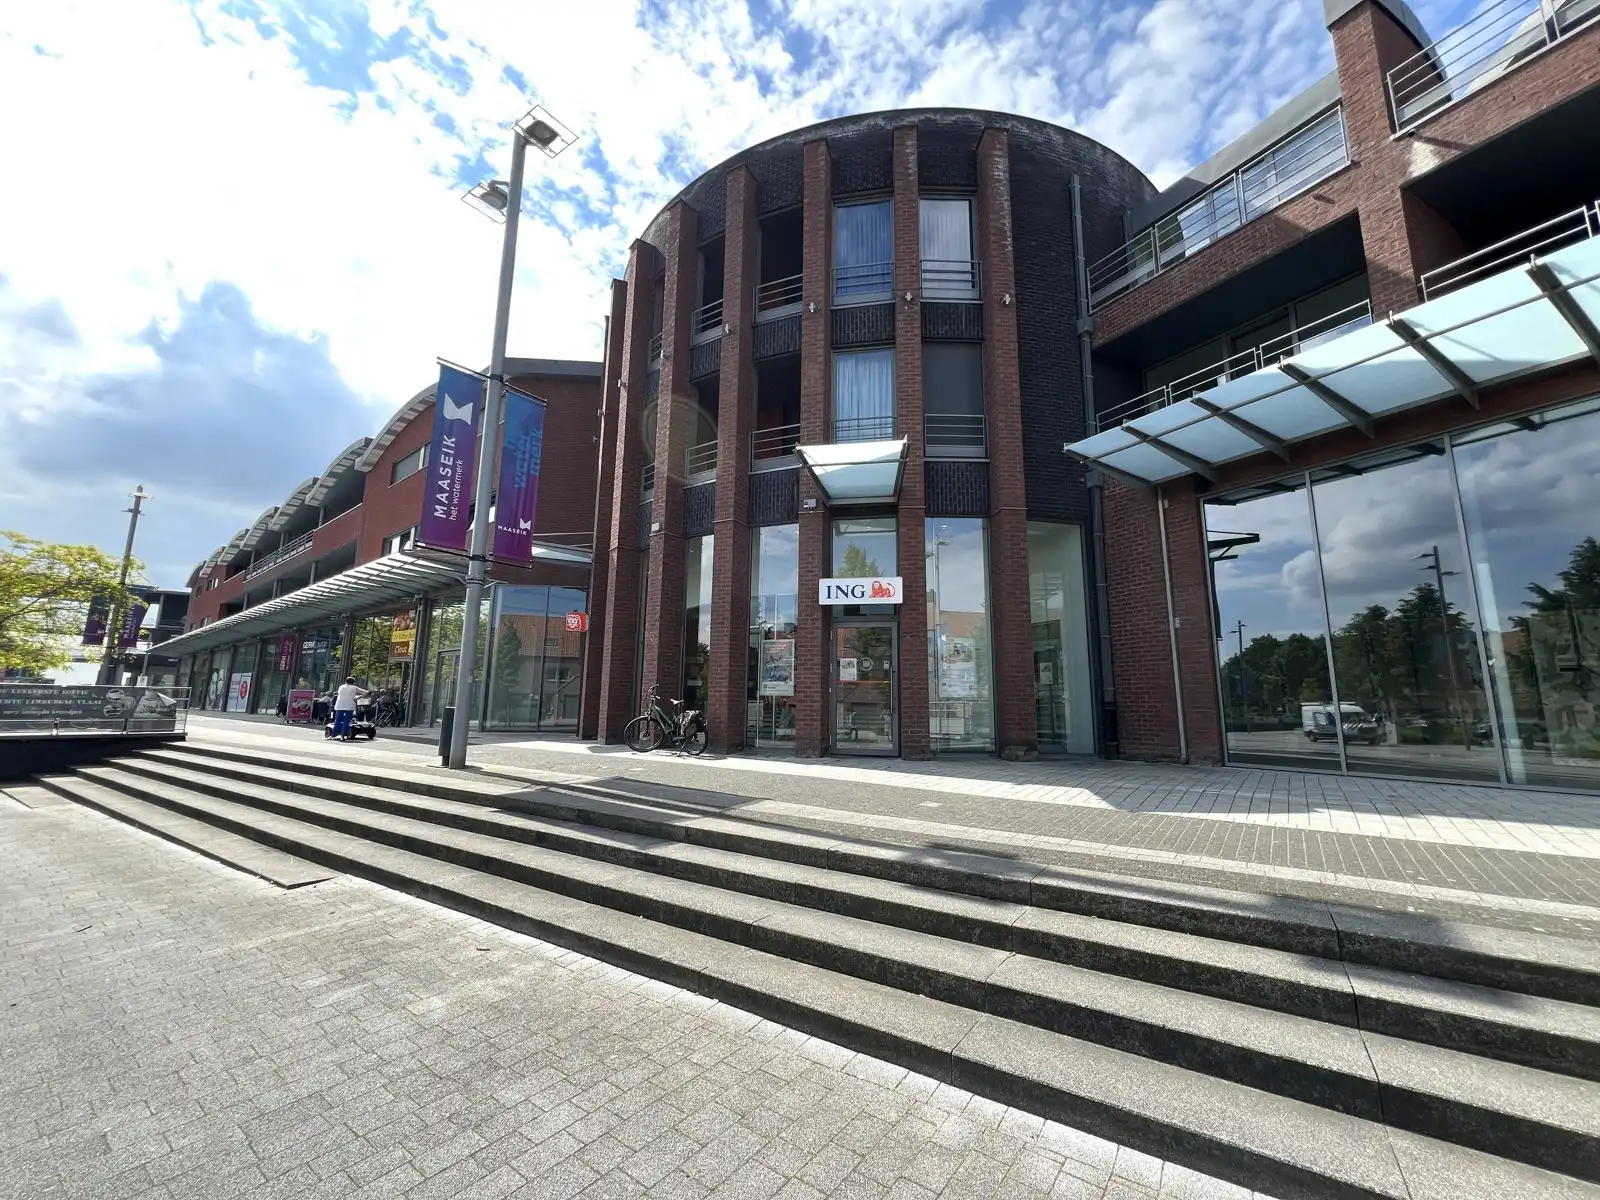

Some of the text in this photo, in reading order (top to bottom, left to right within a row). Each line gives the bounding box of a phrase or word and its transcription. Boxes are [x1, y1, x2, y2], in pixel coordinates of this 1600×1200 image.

[529, 428, 542, 476] merk
[434, 435, 456, 518] MAASEIK
[449, 460, 464, 521] het watermerk
[497, 525, 527, 536] MAASEIK
[826, 584, 866, 599] ING
